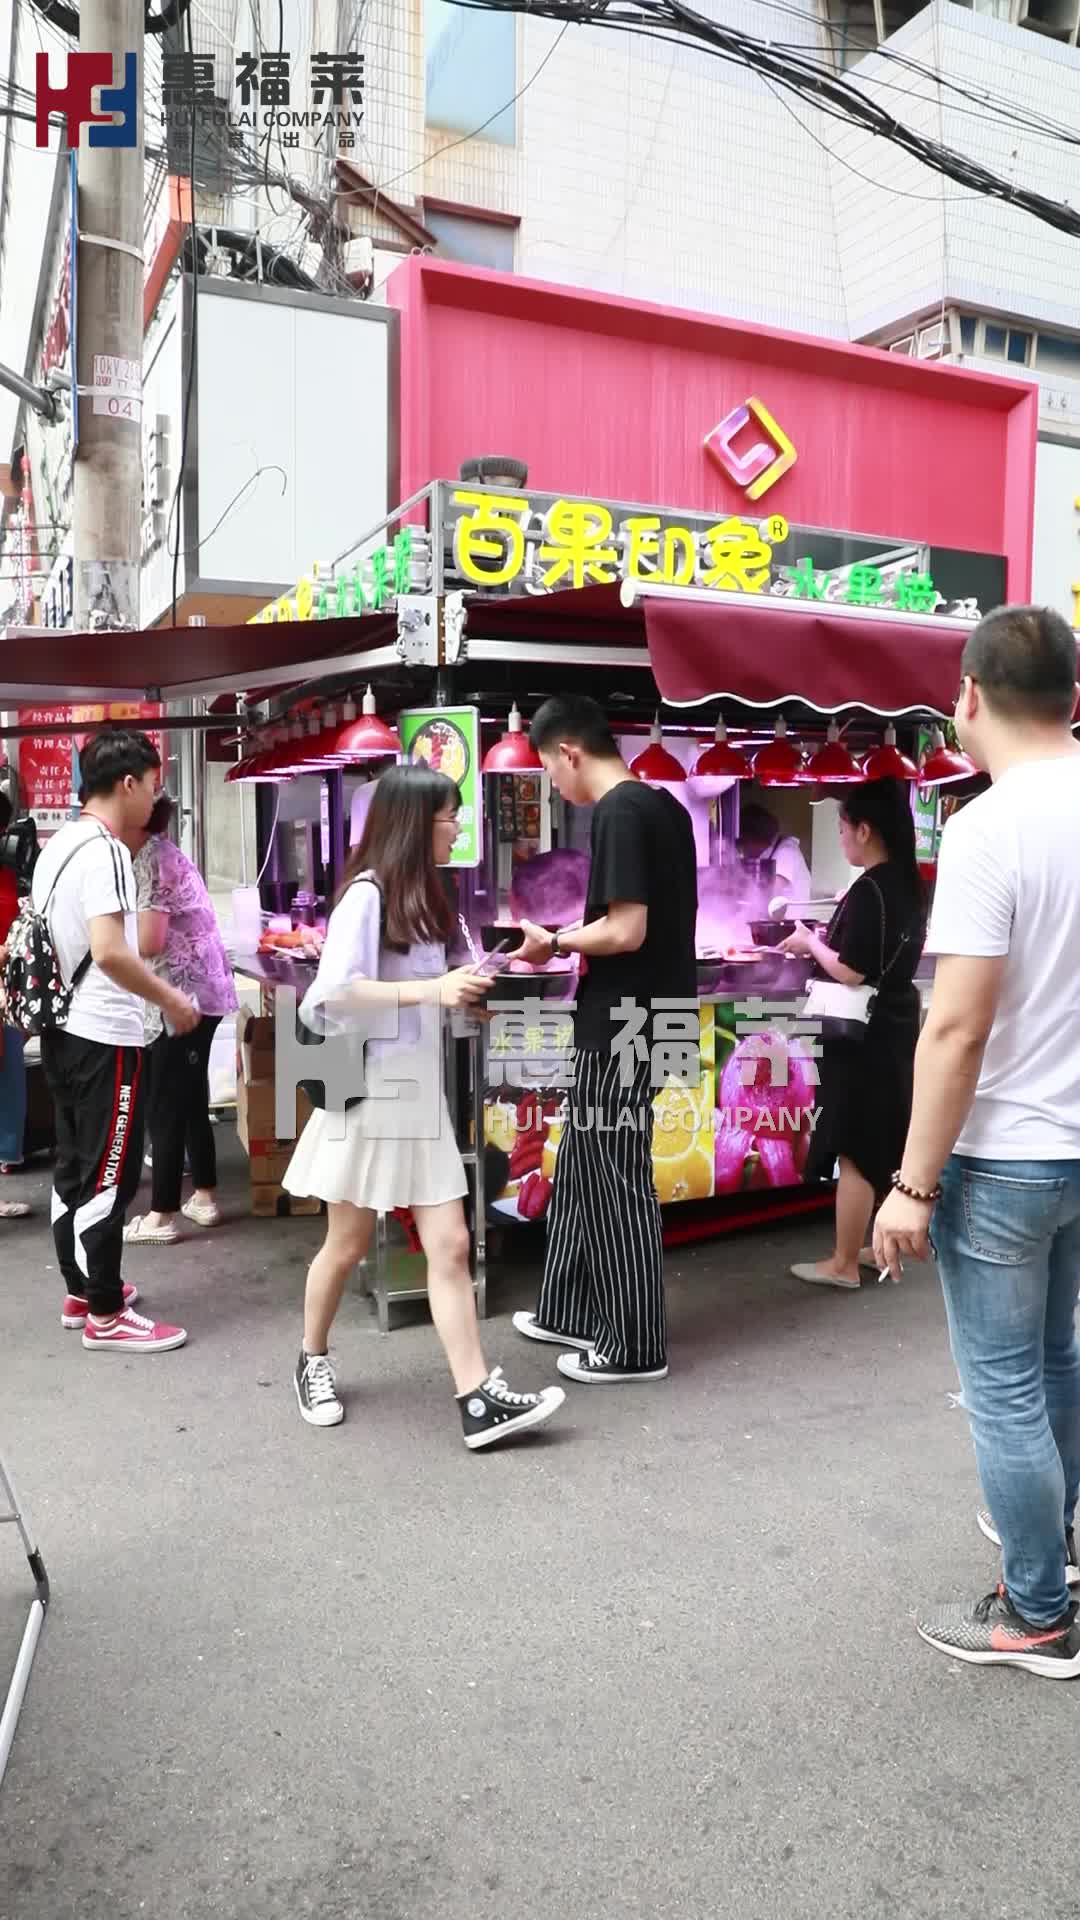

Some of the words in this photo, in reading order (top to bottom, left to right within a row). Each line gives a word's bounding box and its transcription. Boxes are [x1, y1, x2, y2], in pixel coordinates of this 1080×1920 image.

[108, 398, 131, 416] 04
[453, 490, 773, 593] 百果印象
[119, 1085, 132, 1113] NEW
[102, 1114, 129, 1187] GENERATION
